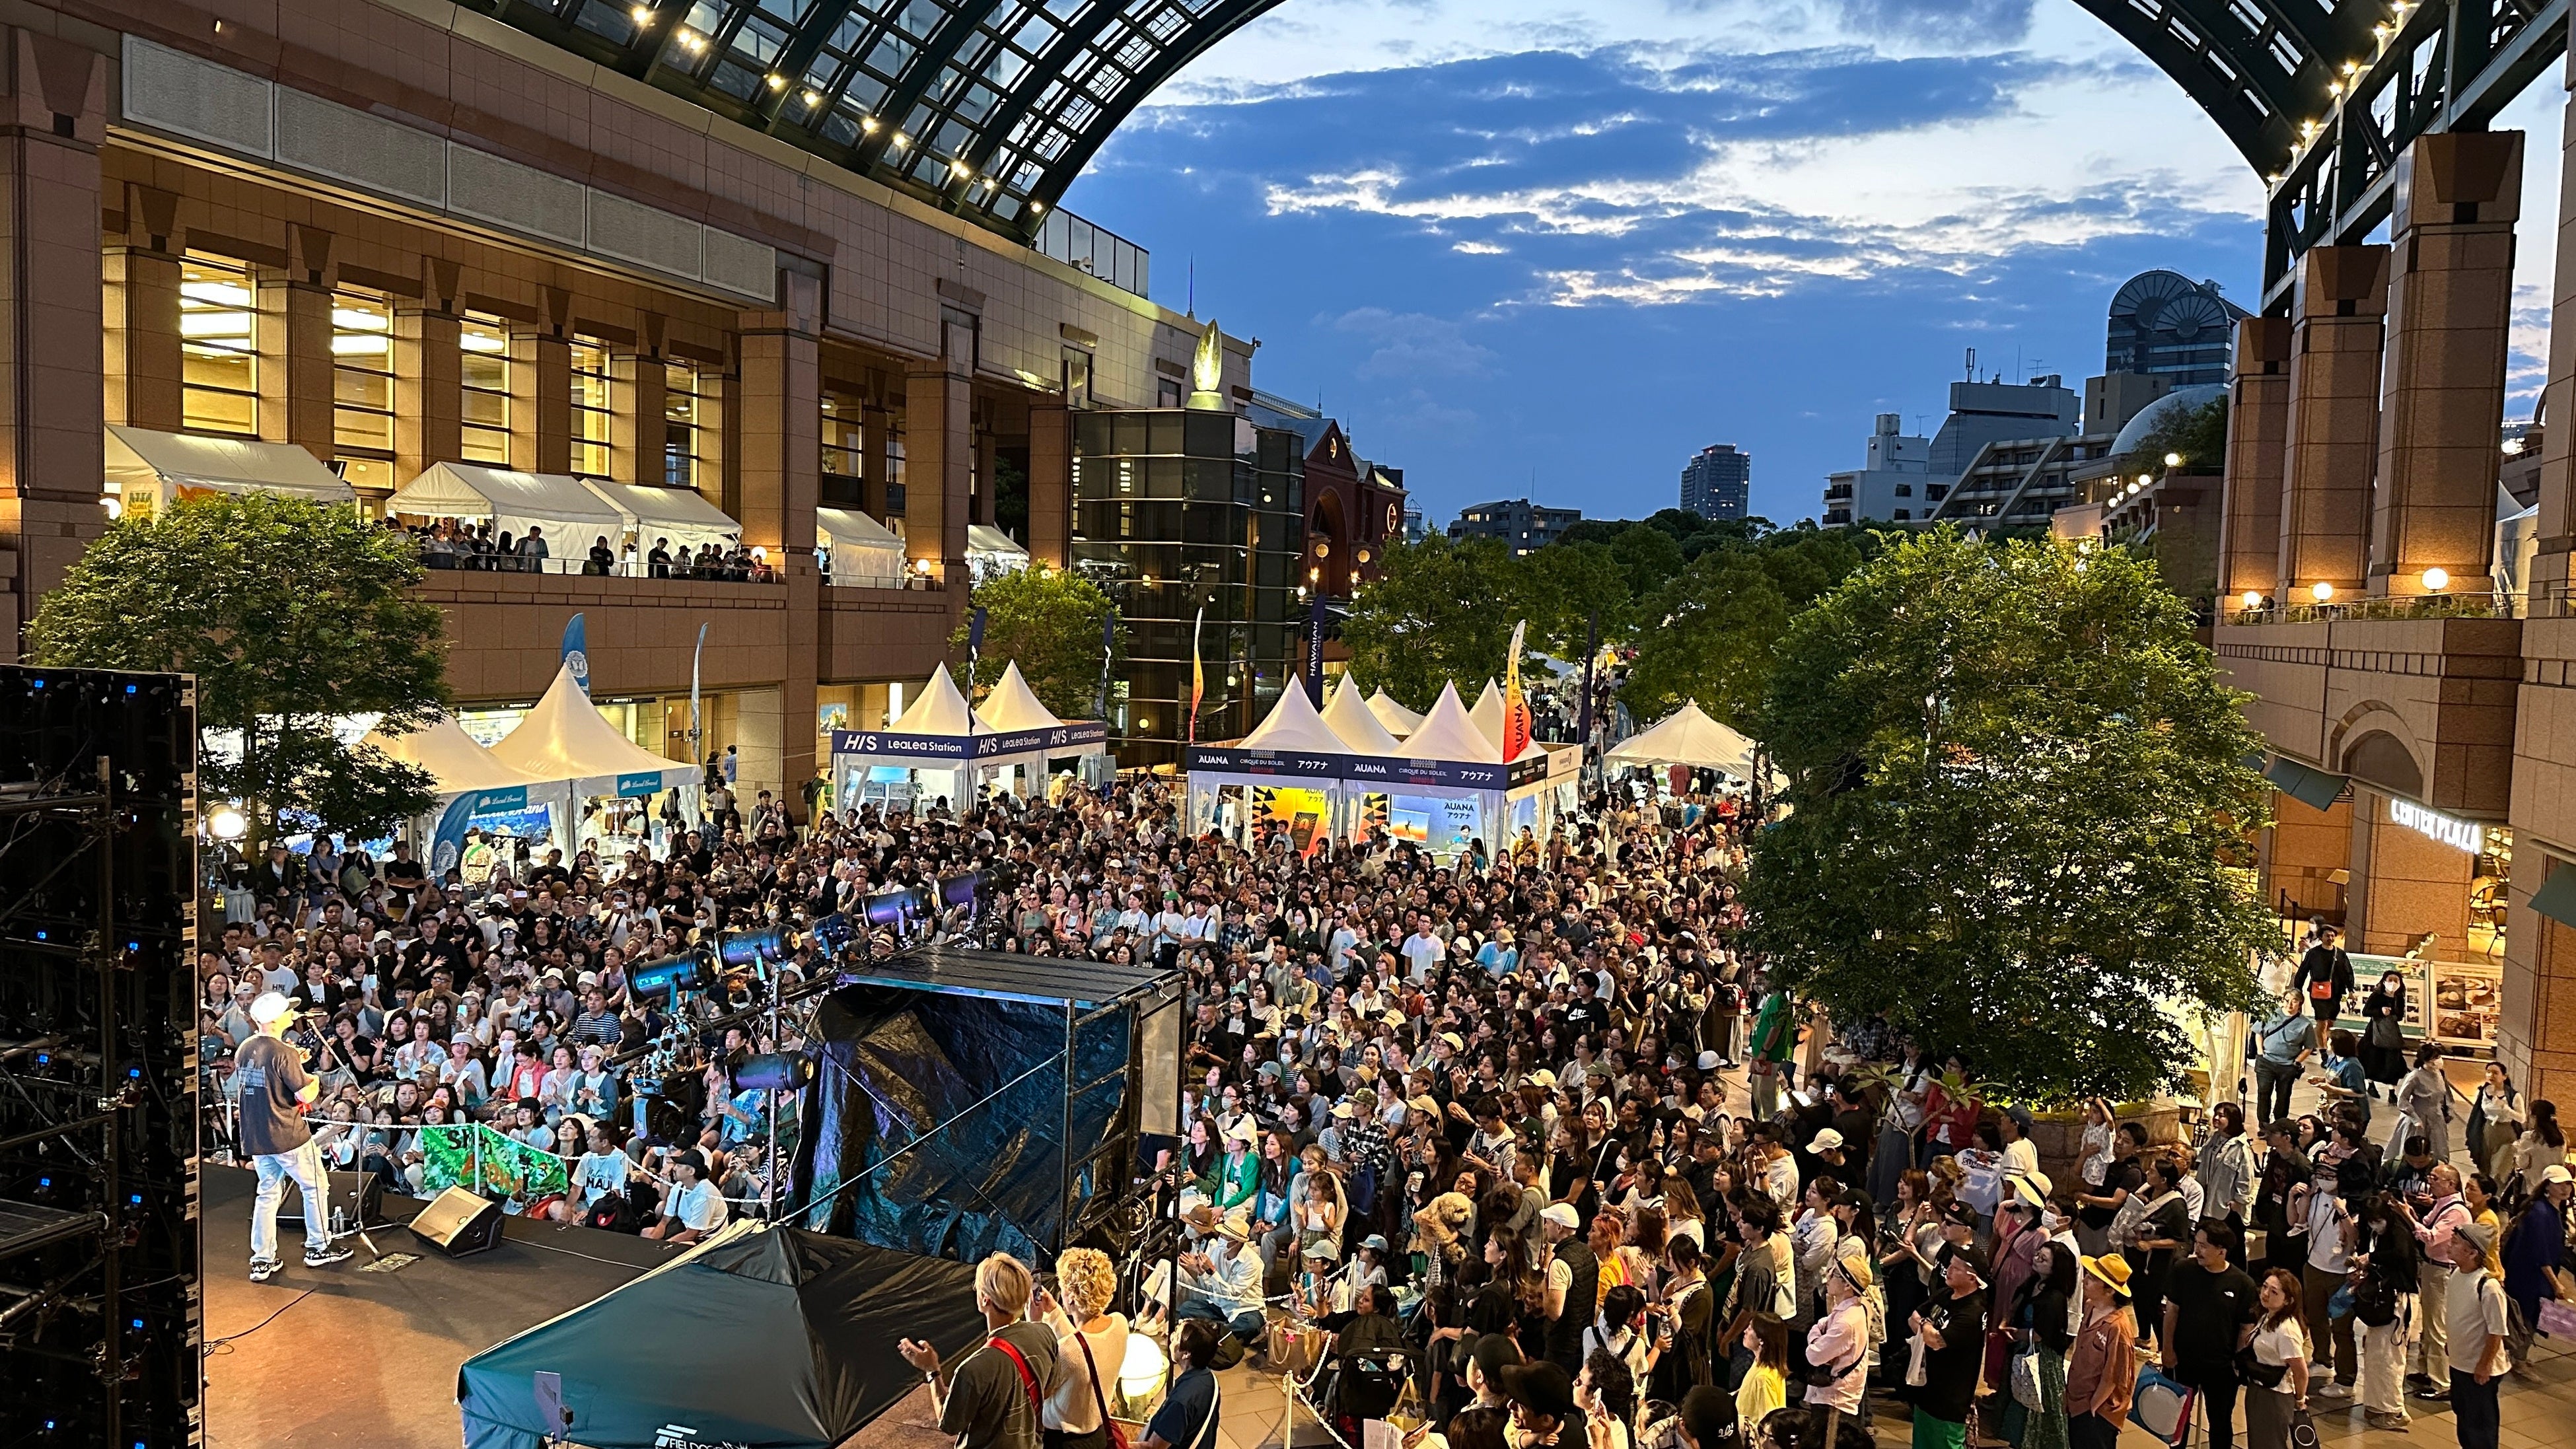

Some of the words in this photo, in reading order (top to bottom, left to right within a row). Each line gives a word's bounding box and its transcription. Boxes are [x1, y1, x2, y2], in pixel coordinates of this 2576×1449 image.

[1310, 621, 1318, 677] HAWAIIAN
[843, 734, 877, 752] HIS
[929, 742, 962, 753] Station
[1050, 729, 1067, 745] HIS
[978, 737, 997, 754] HIS
[1297, 760, 1328, 770] アウアナ
[1460, 770, 1493, 781] アウアナ
[2391, 798, 2437, 840] CENTER
[2436, 816, 2481, 855] PLAZA
[586, 1176, 613, 1192] MAUI
